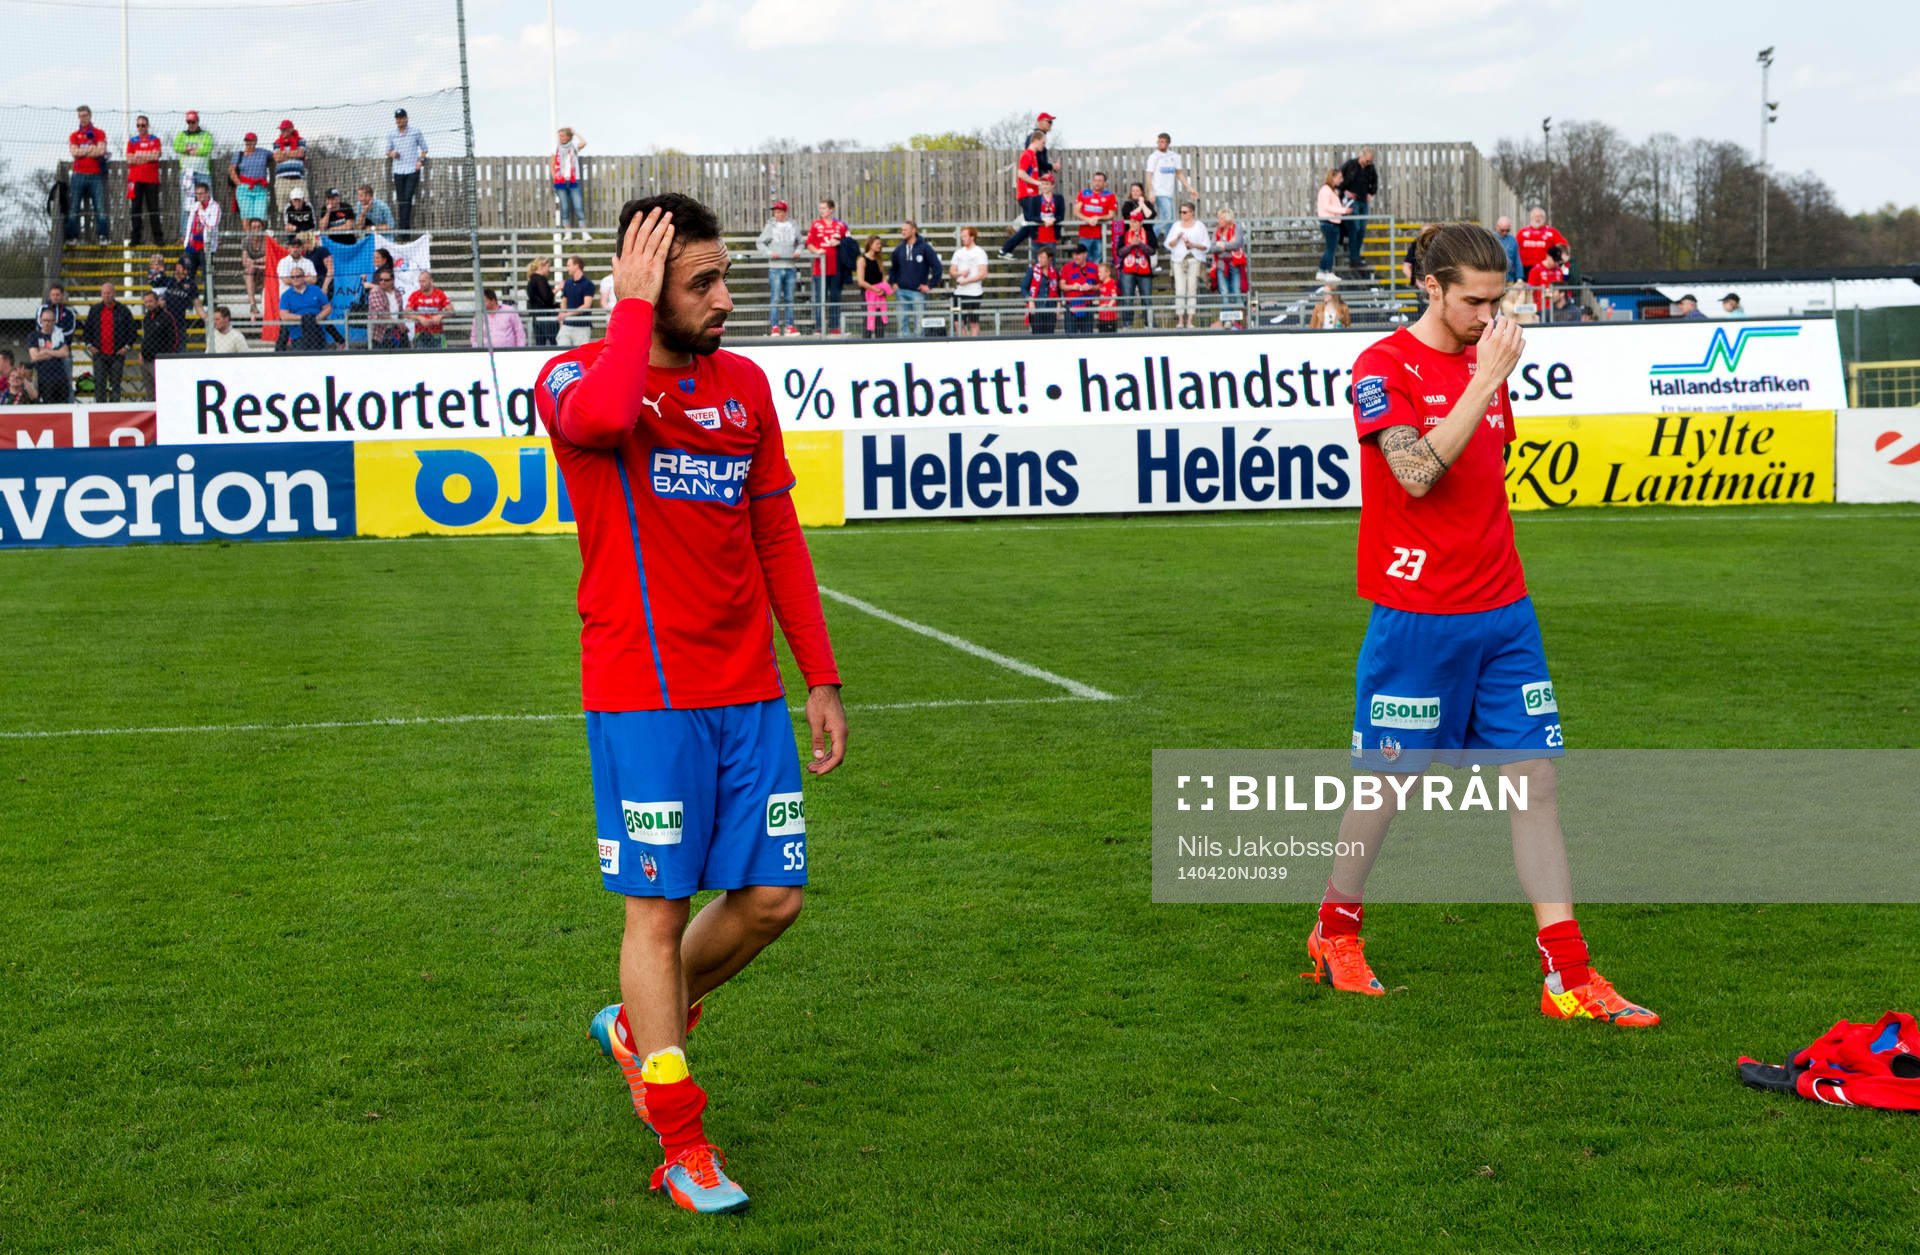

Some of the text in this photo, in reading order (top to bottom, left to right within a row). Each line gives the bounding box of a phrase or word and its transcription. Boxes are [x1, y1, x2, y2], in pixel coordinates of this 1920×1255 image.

[196, 375, 490, 434] Resekortet
[851, 360, 1029, 419] rabatt!
[1649, 376, 1810, 395] Hallandstrafiken
[1647, 415, 1775, 469] Hylte
[862, 432, 1081, 511] Heléns
[1136, 426, 1351, 505] Heléns
[1600, 461, 1816, 504] Lantmän
[0, 453, 337, 539] verion
[1386, 546, 1427, 581] 23
[1386, 702, 1439, 719] SOLID
[1544, 724, 1564, 748] 23
[633, 810, 683, 830] SOLID
